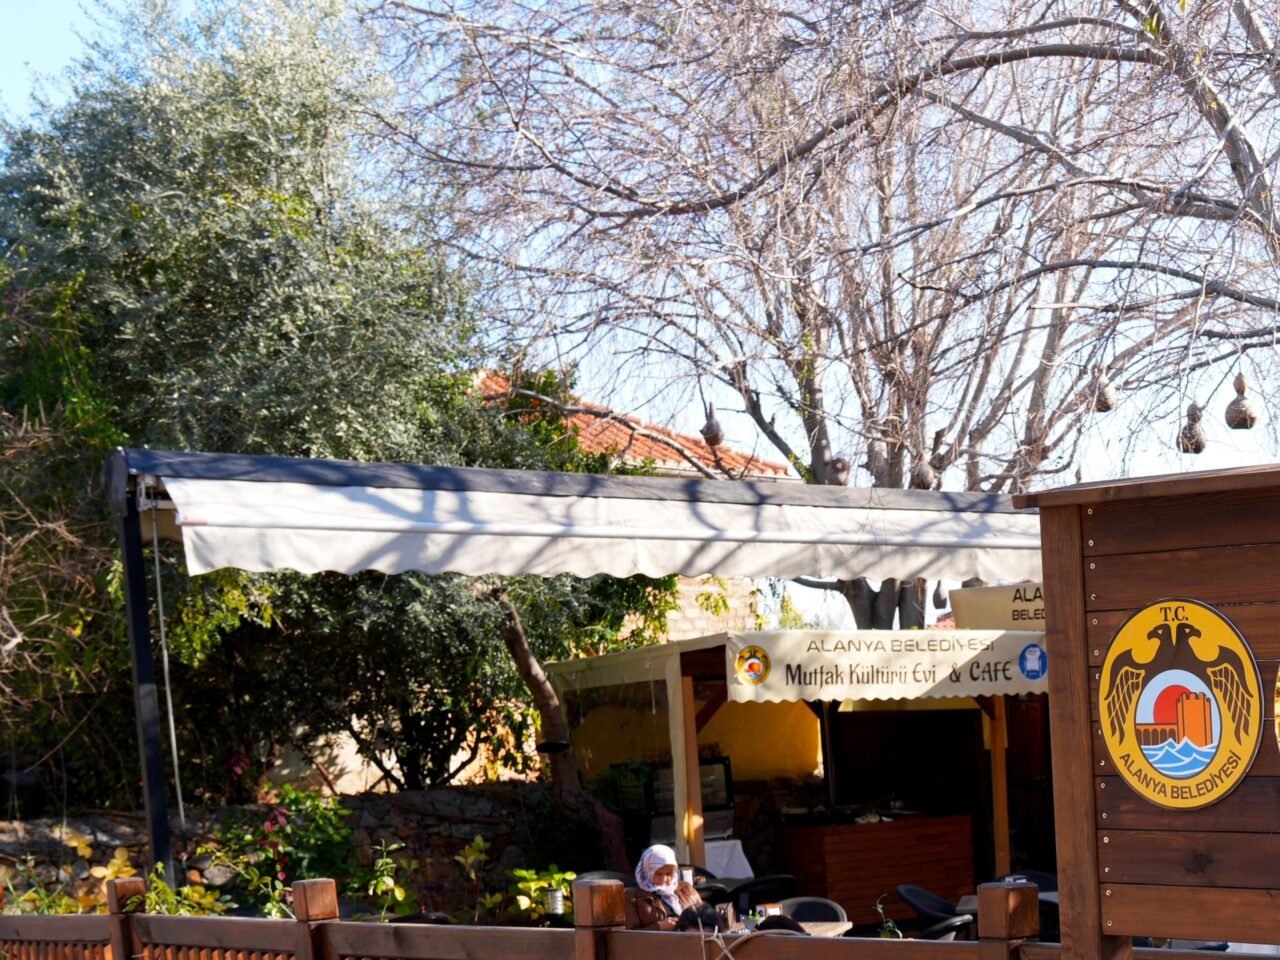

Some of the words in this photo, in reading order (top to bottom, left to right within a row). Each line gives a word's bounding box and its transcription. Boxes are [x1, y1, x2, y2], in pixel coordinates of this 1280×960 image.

[1012, 587, 1044, 603] ALA
[1159, 605, 1189, 622] T.C.
[806, 639, 887, 653] ALANYA
[785, 663, 844, 690] Mutfak
[913, 662, 937, 683] Evi
[949, 662, 962, 683] &
[969, 660, 1013, 682] CAFE
[1119, 753, 1168, 798] ALANYA
[1170, 749, 1242, 800] BELEDİYESİ
